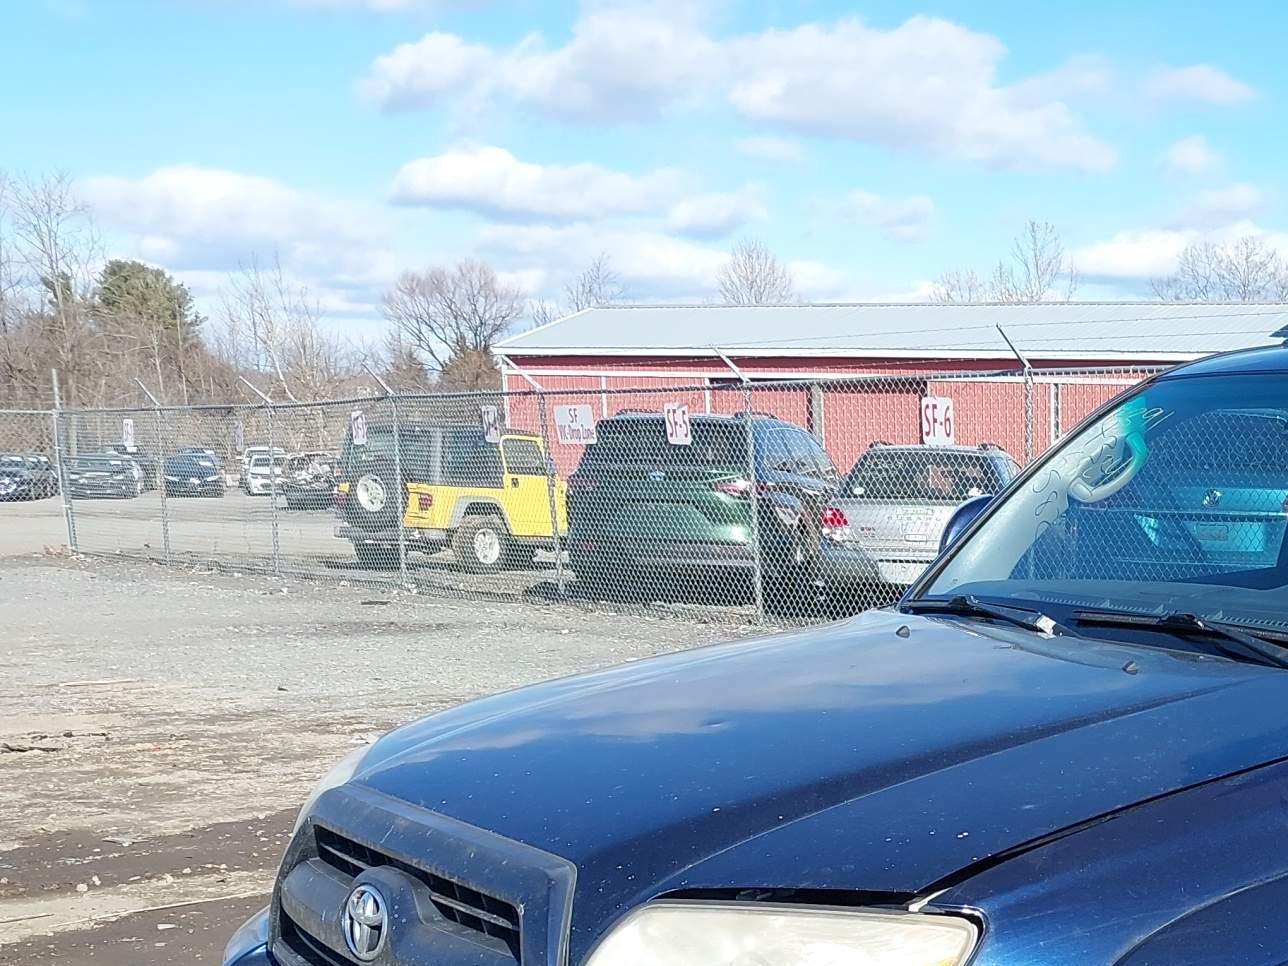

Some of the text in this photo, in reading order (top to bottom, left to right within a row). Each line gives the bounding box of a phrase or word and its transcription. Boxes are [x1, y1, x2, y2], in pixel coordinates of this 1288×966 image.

[568, 407, 578, 424] SF
[666, 408, 689, 438] SF-5
[924, 403, 952, 438] SF-6
